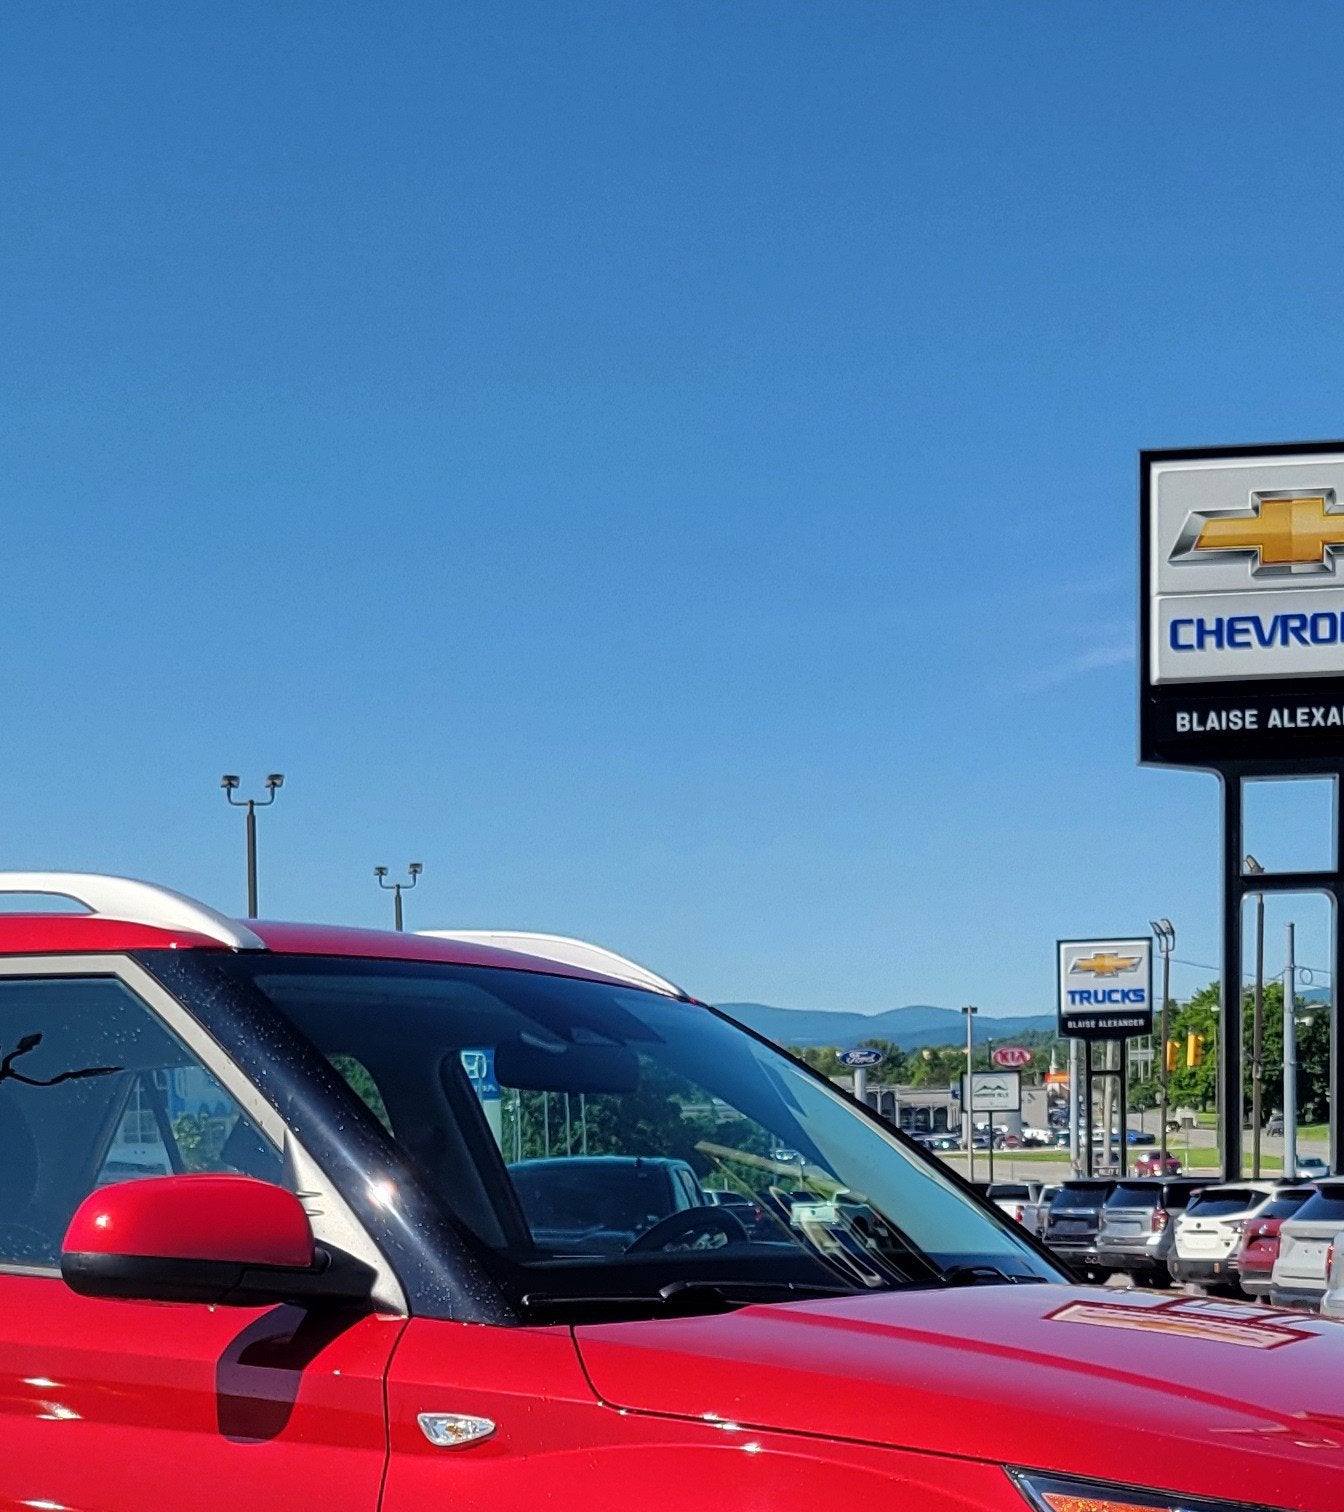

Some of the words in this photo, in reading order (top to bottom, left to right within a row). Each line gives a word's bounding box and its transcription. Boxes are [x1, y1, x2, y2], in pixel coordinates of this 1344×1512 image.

[1175, 709, 1258, 732] BLAISE
[1067, 988, 1145, 1005] TRUCKS
[1067, 1020, 1096, 1029] BLAISE
[1098, 1018, 1145, 1028] ALEXANDER
[846, 1051, 876, 1065] Ford
[998, 1050, 1026, 1063] KIA
